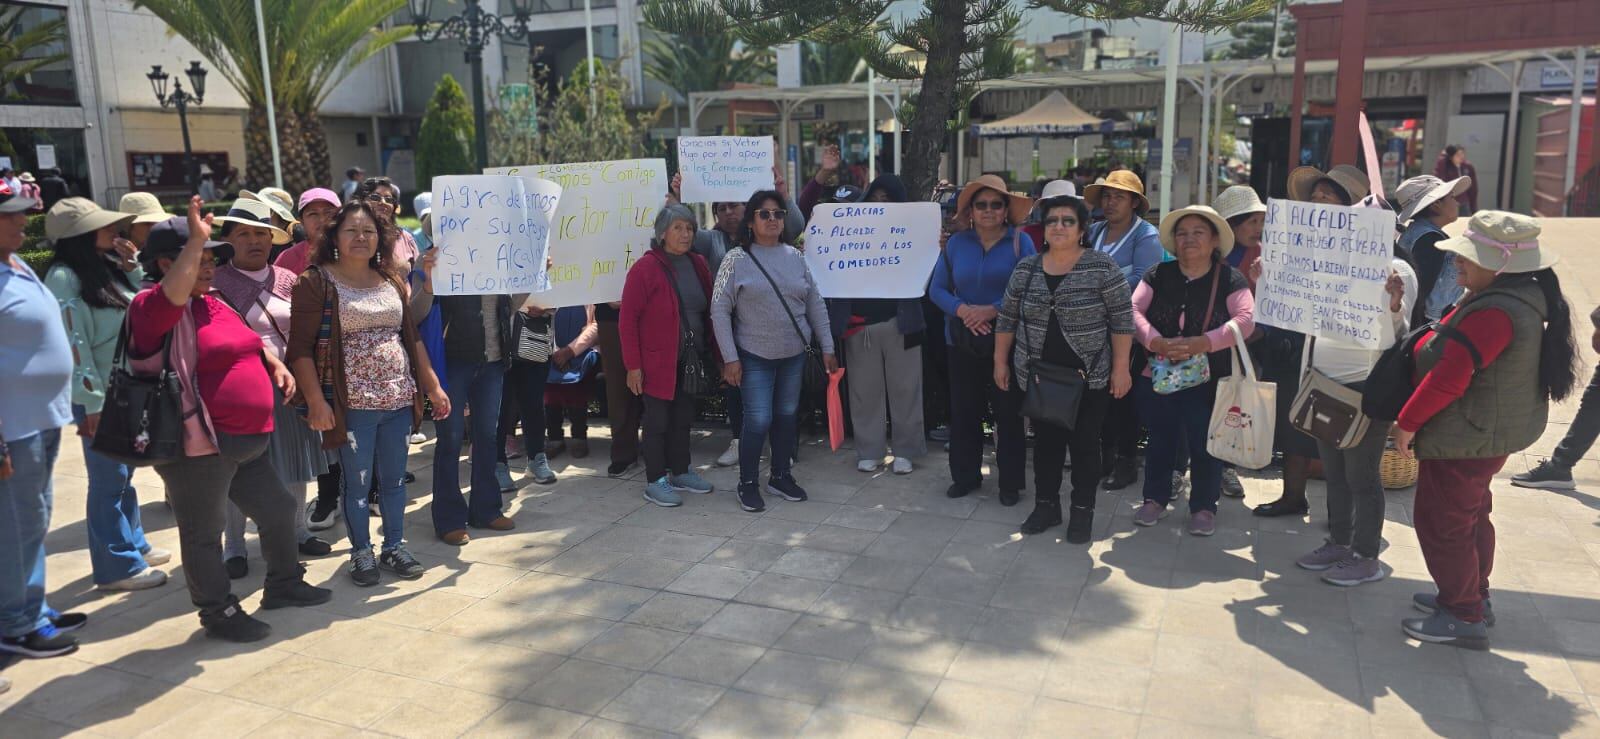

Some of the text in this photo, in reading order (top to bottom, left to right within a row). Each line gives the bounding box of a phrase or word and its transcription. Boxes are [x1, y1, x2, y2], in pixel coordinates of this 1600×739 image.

[702, 152, 716, 160] por
[722, 146, 731, 158] el
[739, 150, 767, 161] apoyo
[601, 160, 656, 186] Contigo
[833, 206, 885, 218] GRACIAS
[1291, 205, 1359, 233] ALCALDE
[439, 215, 470, 236] por
[831, 225, 876, 238] ALCALDE
[890, 226, 906, 235] POR
[817, 241, 912, 255] SU APOYO A LOS
[1264, 230, 1388, 258] VICTOR HUGO RIVERA
[828, 255, 901, 271] COMEDORES
[451, 273, 464, 292] El
[1313, 317, 1334, 331] SAN
[1367, 317, 1374, 325] Y
